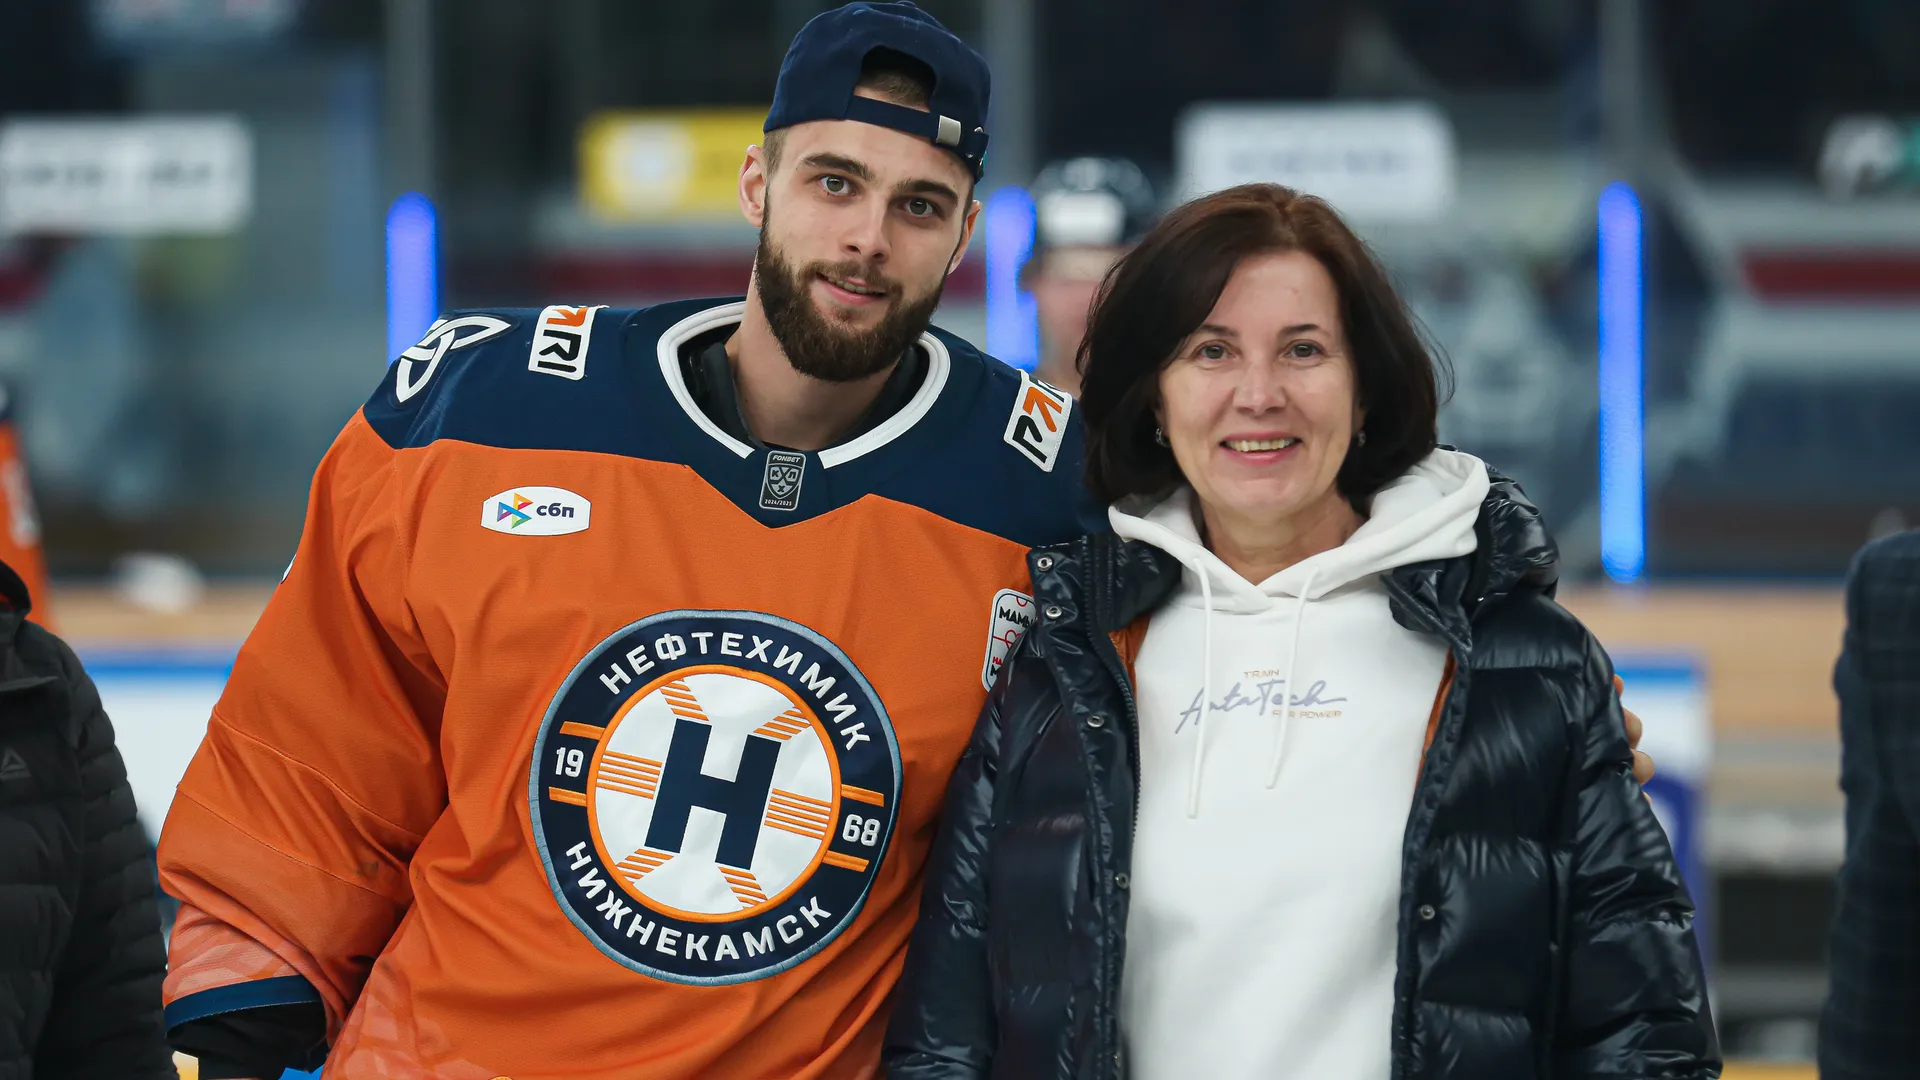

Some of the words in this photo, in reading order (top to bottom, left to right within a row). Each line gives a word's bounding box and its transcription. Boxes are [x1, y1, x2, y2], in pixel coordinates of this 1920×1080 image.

[772, 454, 801, 463] FONBET
[536, 502, 575, 518] сбп
[1244, 669, 1280, 679] TRAIN
[599, 631, 870, 751] НЕФТЕХИМИК
[1272, 710, 1296, 719] FR
[1299, 710, 1342, 720] POWER
[555, 747, 585, 778] 19
[842, 813, 881, 847] 68
[565, 841, 832, 962] НИЖНЕКАМСК
